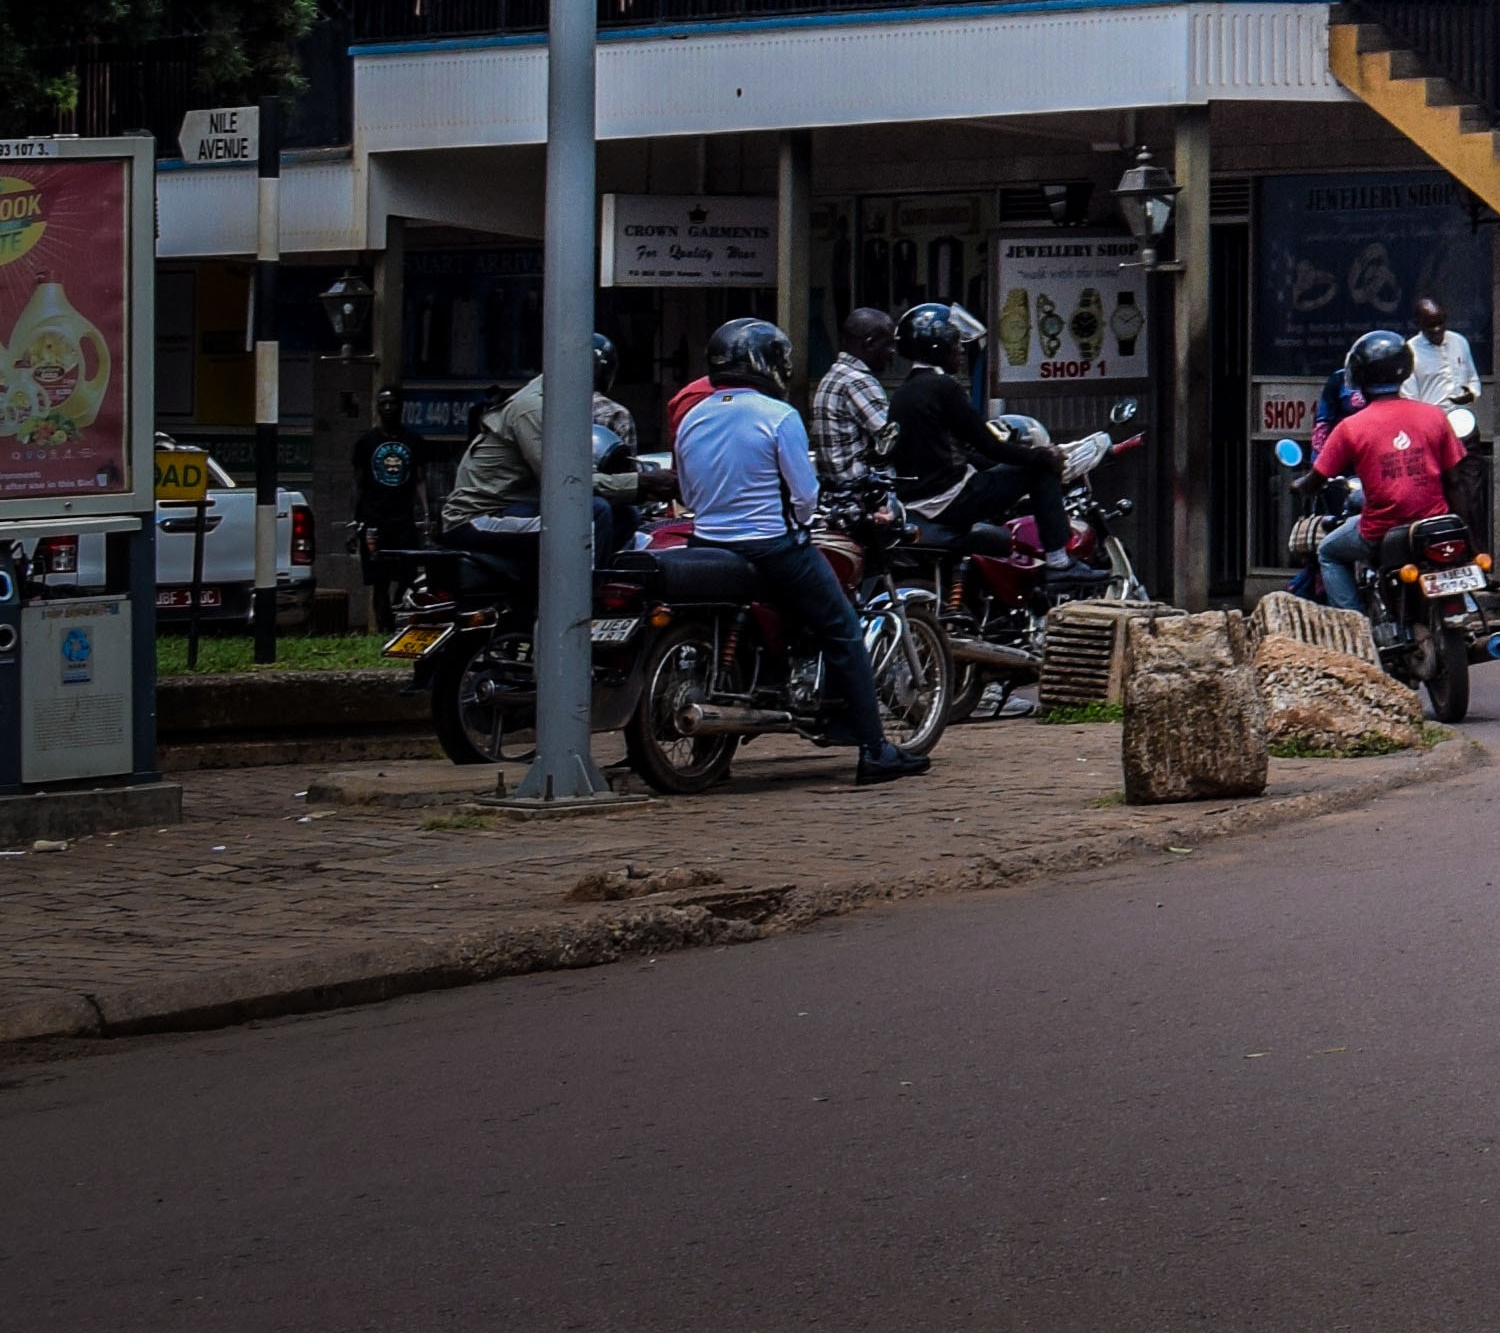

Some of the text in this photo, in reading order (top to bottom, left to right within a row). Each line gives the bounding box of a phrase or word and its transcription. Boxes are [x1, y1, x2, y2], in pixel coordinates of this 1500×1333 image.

[208, 111, 238, 134] NILE
[15, 143, 34, 156] 107
[198, 137, 249, 161] AVENUE
[625, 224, 770, 239] CROWN GARMENTS
[1006, 243, 1139, 259] JEWELLERY SHOP
[1040, 360, 1106, 378] SHOP 1
[1264, 400, 1306, 429] SHOP
